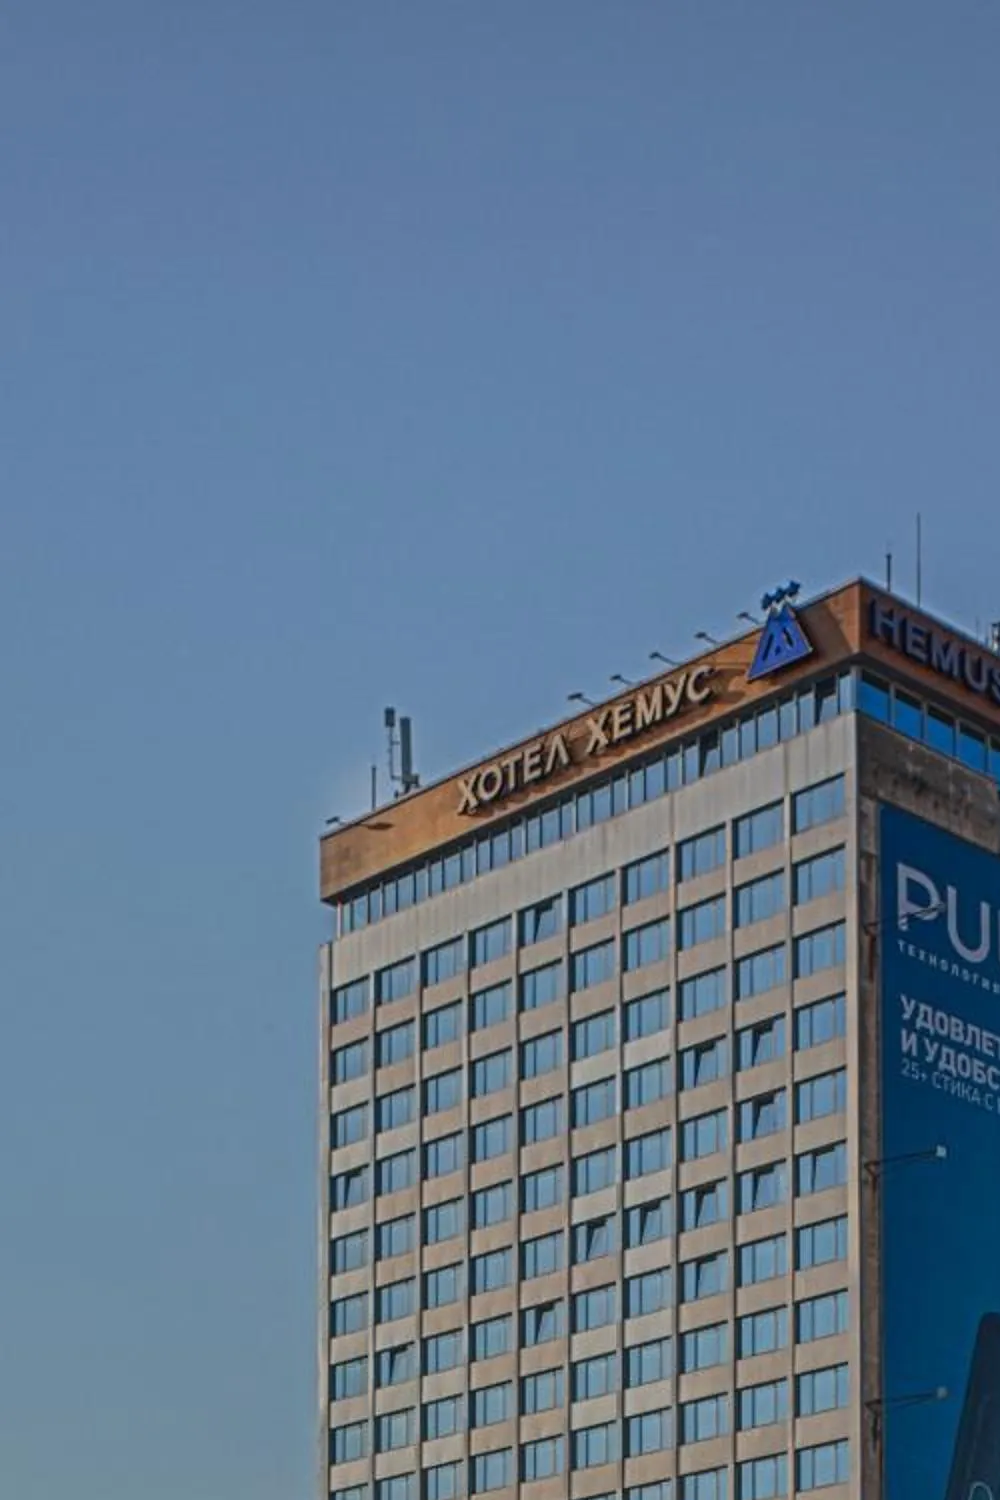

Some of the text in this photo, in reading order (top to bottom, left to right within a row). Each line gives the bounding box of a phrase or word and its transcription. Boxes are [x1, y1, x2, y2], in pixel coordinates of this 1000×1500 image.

[458, 664, 713, 814] ХОТЕЛ ХЕМУС
[900, 1027, 918, 1058] И
[931, 1070, 981, 1104] СТИКА
